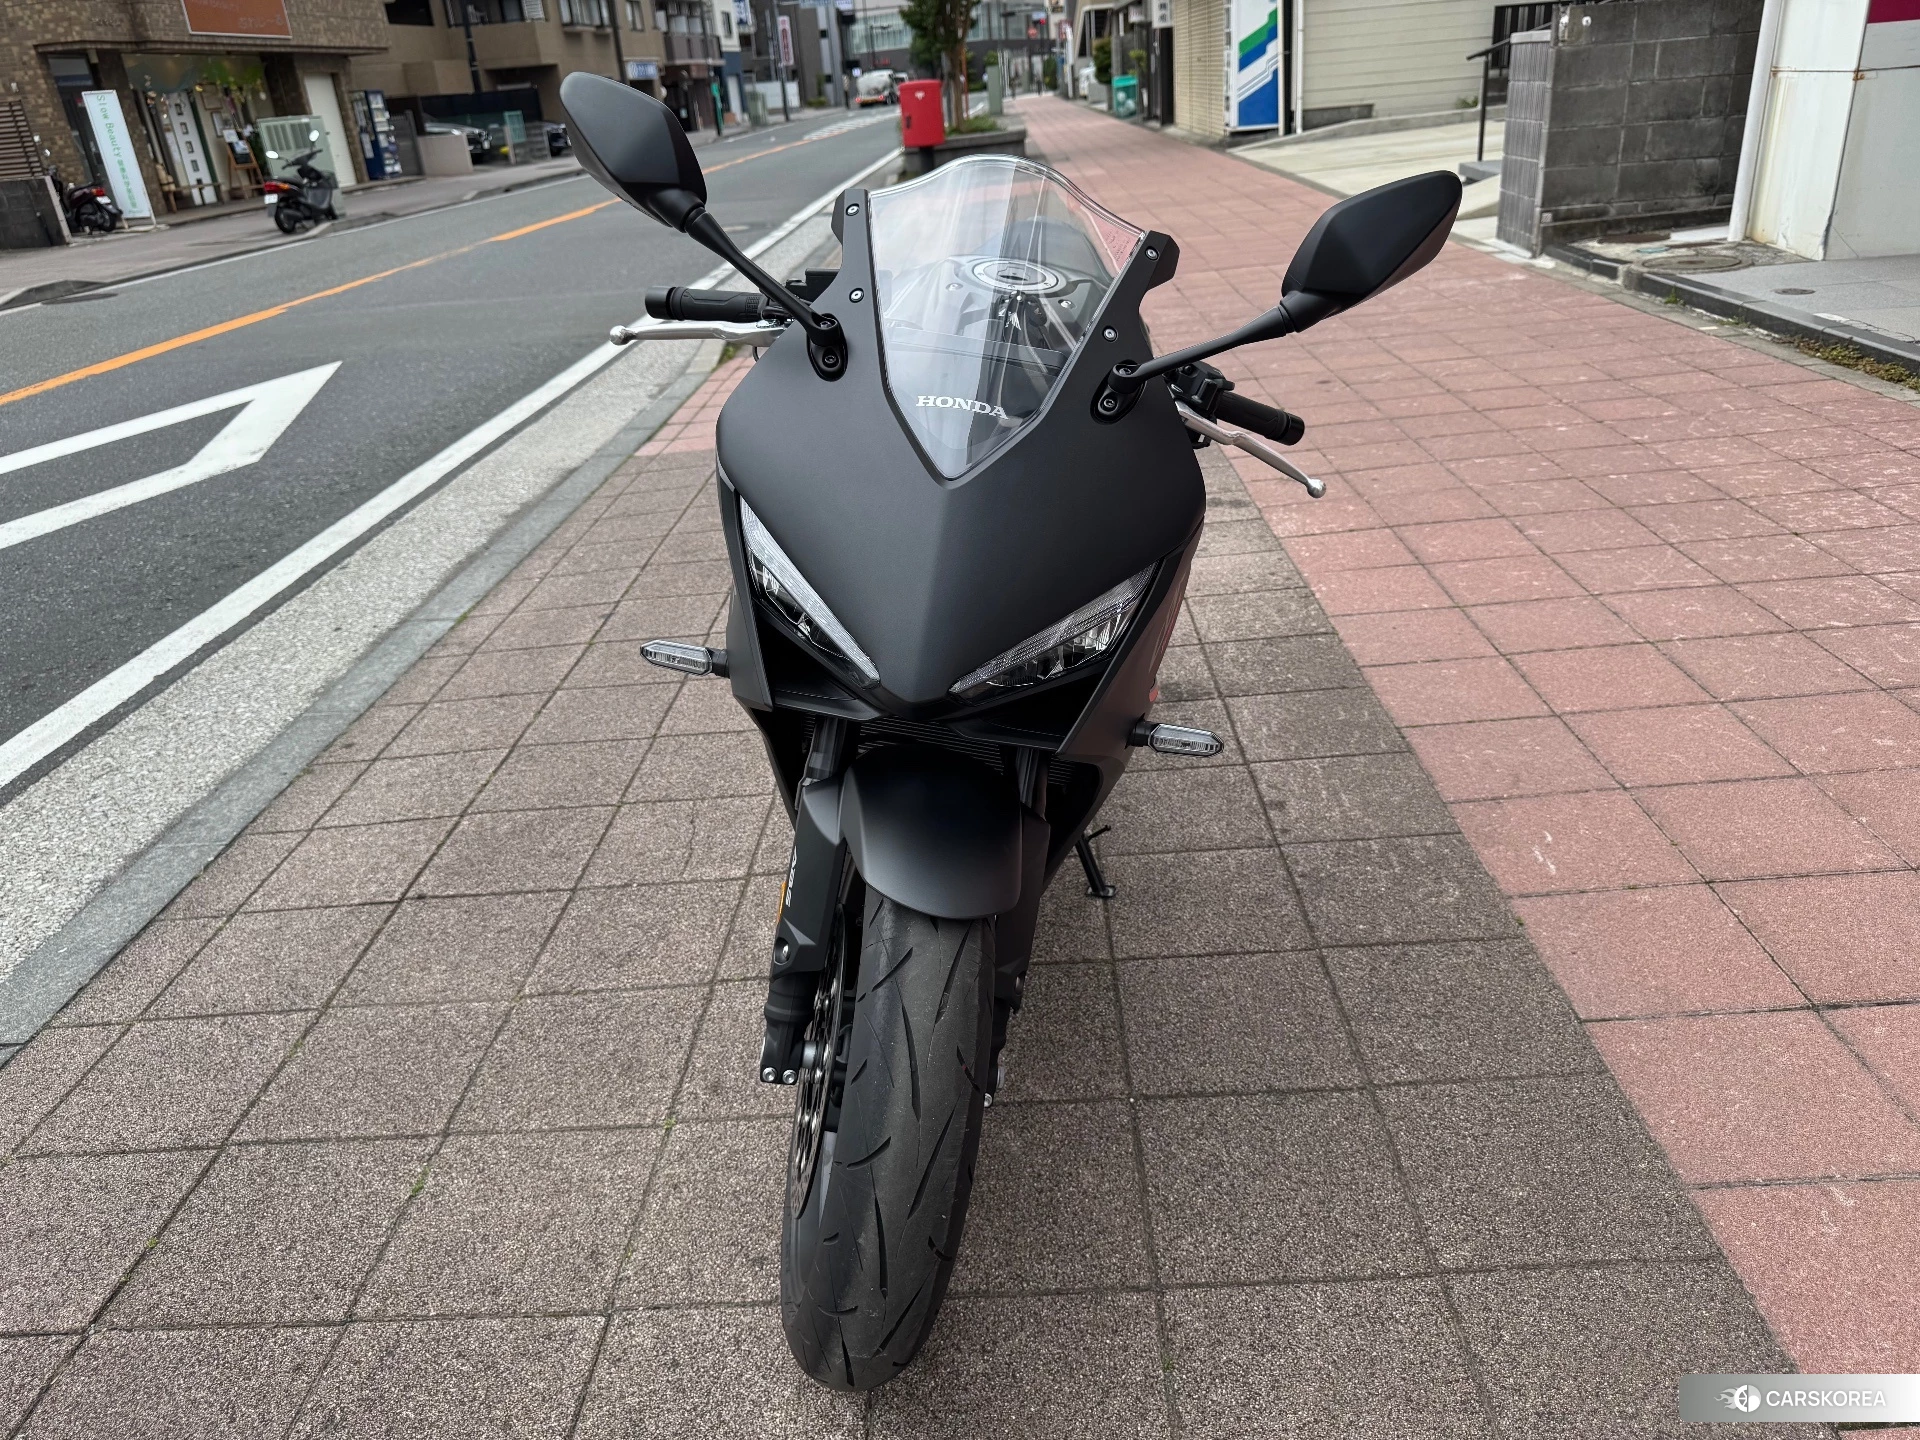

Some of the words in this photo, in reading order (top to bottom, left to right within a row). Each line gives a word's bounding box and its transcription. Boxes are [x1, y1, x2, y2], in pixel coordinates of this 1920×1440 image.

[96, 94, 110, 120] Slow
[105, 122, 122, 157] Beauty
[916, 395, 1009, 419] HONDA
